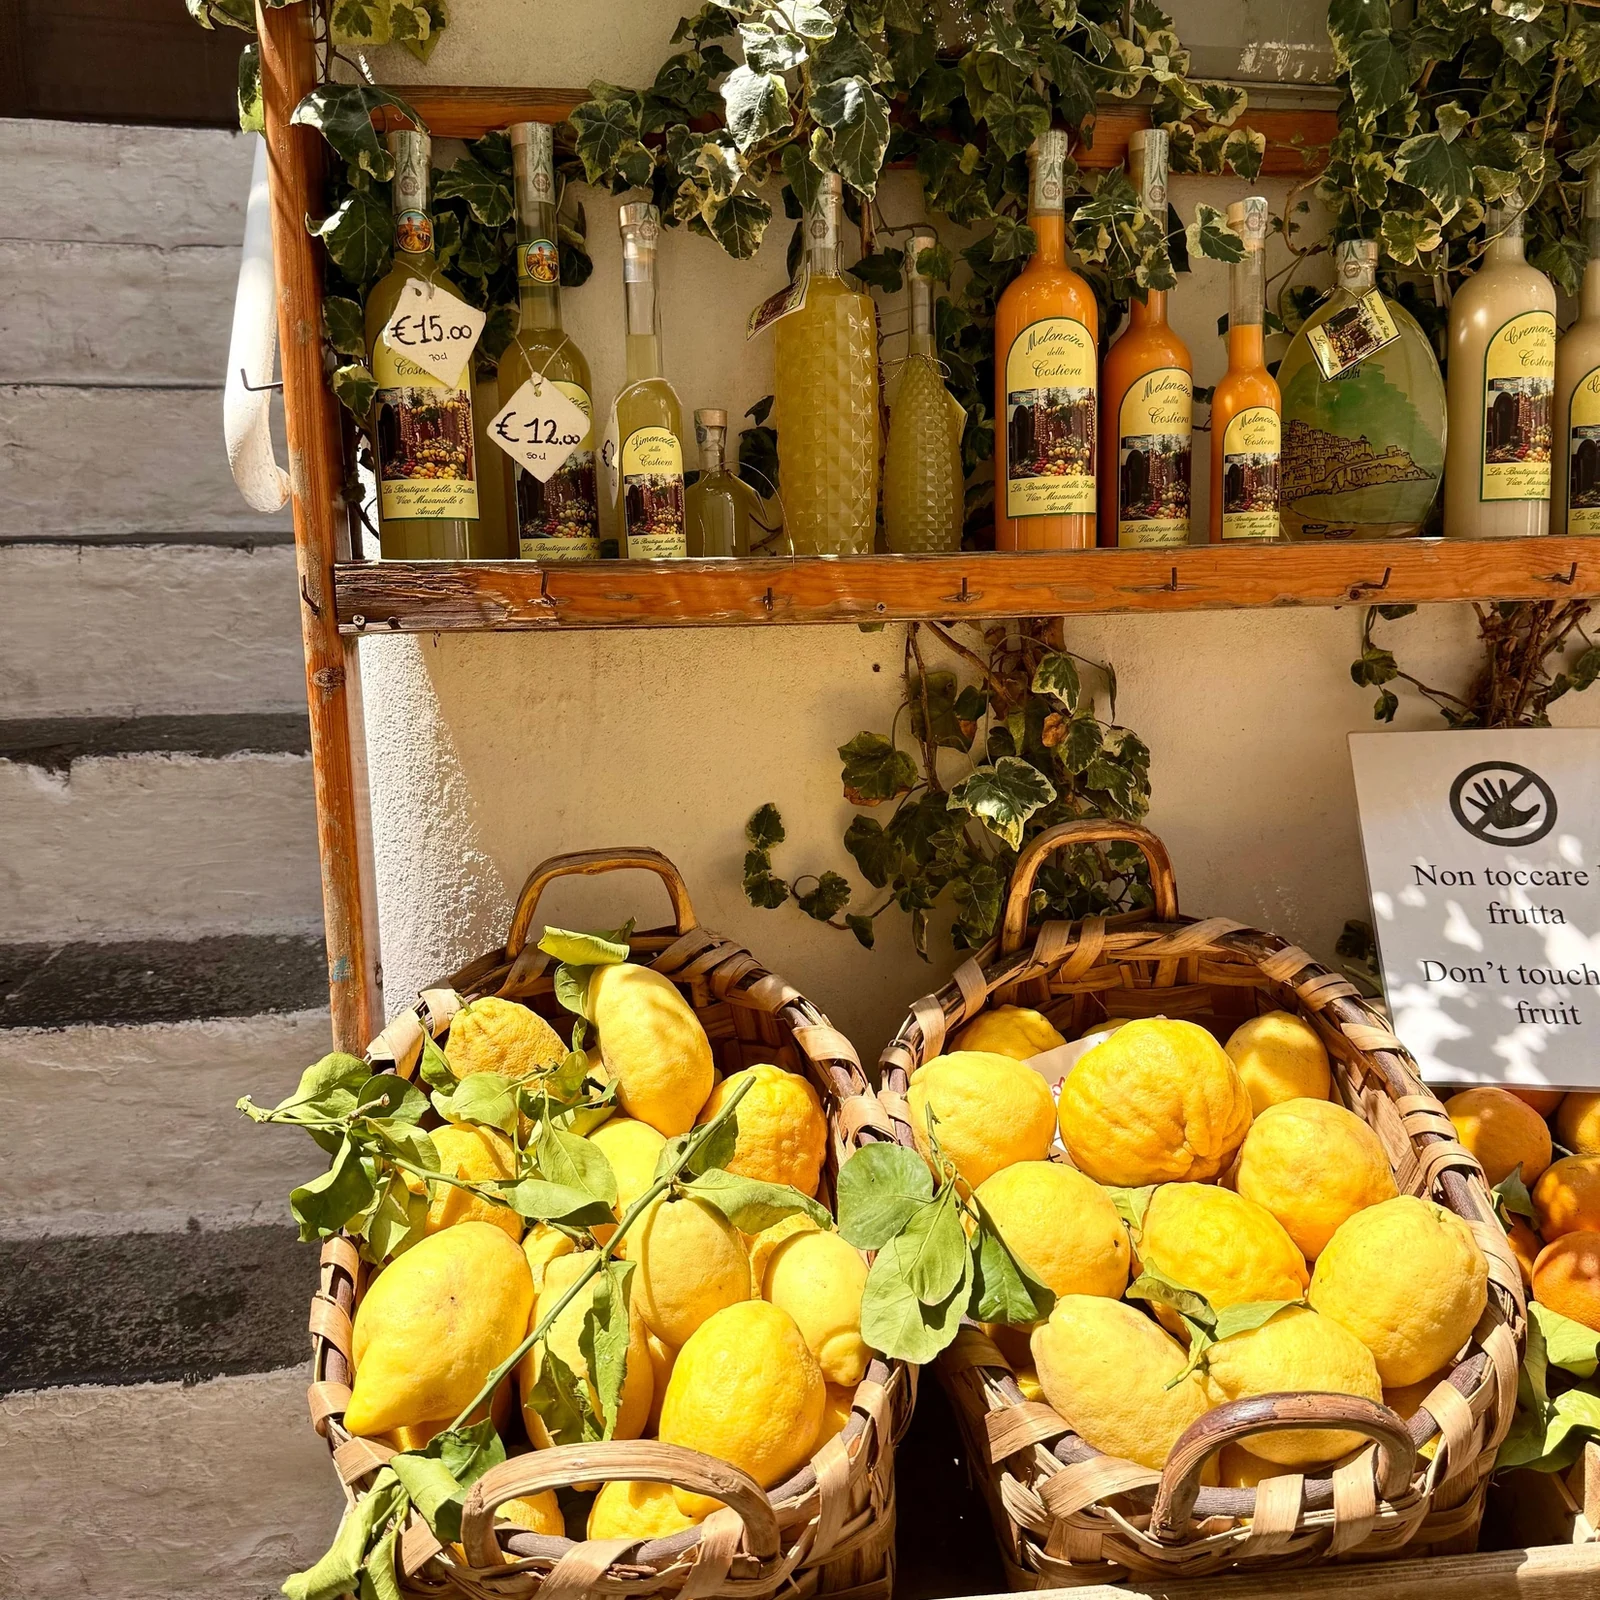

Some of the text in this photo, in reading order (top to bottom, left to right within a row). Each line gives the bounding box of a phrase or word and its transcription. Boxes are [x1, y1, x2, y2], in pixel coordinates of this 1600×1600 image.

[390, 314, 472, 345] €15.00
[1025, 326, 1085, 355] Meloncino
[1046, 347, 1066, 356] della
[1032, 360, 1082, 378] Costiera
[1141, 375, 1192, 402] Meloncino
[1162, 395, 1179, 404] della
[1148, 407, 1189, 424] Costiera
[1239, 412, 1277, 431] Meloncino
[495, 411, 581, 445] €12.00
[631, 435, 677, 451] Limoncello
[1243, 434, 1275, 446] Costiera
[639, 454, 673, 467] Costiera
[1487, 467, 1502, 476] La
[1503, 466, 1538, 477] Boutique
[1010, 483, 1022, 492] La
[1023, 482, 1060, 492] Boutique
[1061, 480, 1079, 489] della
[1506, 477, 1523, 486] Vico
[383, 484, 475, 495] La Boutique della Frutta
[396, 496, 412, 504] Vico
[413, 495, 457, 504] Masaniello
[1026, 493, 1042, 502] Vico
[1043, 491, 1083, 500] Masaniello
[415, 506, 446, 518] Amalfi
[1044, 502, 1073, 513] Amalfi
[1571, 510, 1586, 520] La
[1121, 524, 1135, 533] La
[1136, 524, 1171, 534] Boutique
[1138, 534, 1155, 543] Vico
[522, 543, 533, 552] La
[534, 543, 570, 553] Boutique
[571, 542, 588, 551] della
[1410, 864, 1477, 887] Non
[1483, 867, 1590, 887] toccare
[1486, 901, 1567, 925] frutta
[1421, 960, 1600, 986] Don’t touch
[1514, 1000, 1583, 1025] fruit
